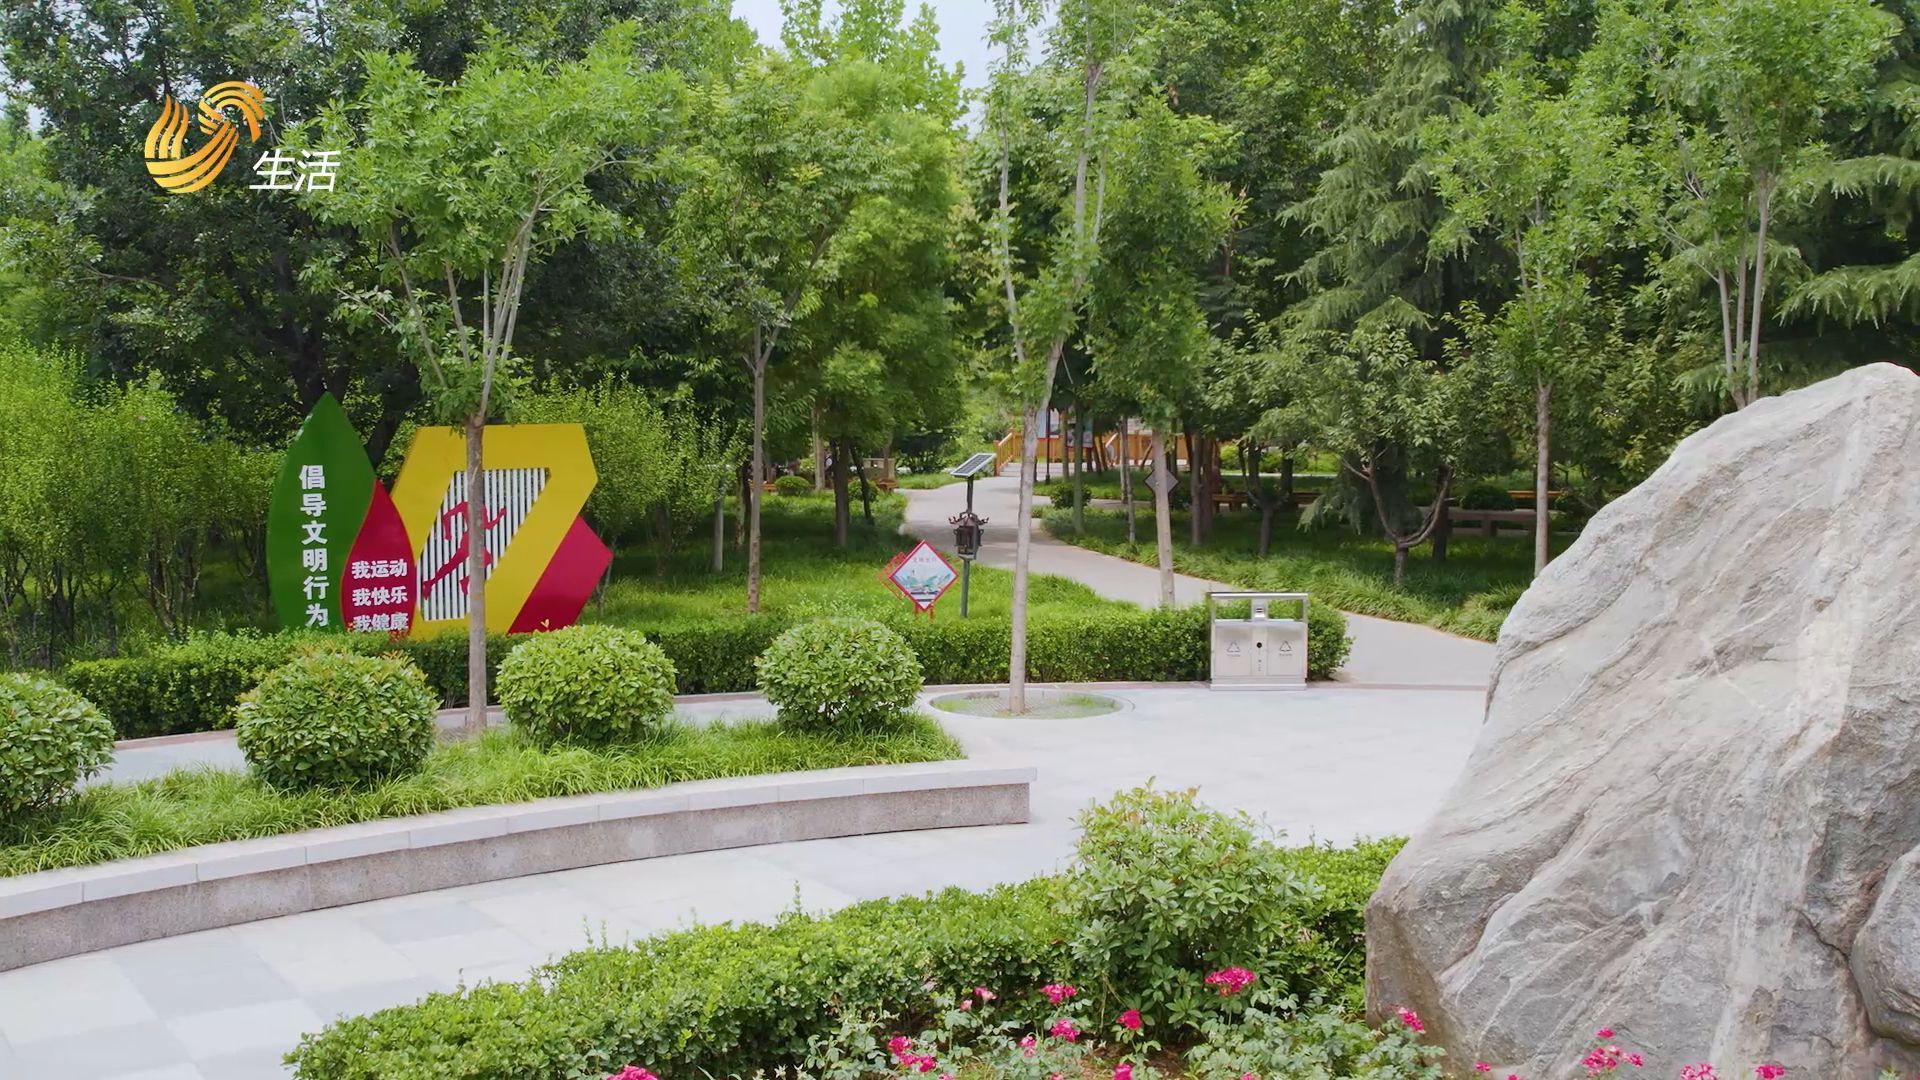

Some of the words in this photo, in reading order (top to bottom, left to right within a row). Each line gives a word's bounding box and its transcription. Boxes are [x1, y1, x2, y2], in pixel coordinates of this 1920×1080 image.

[299, 465, 330, 628] 倡导文明行为
[351, 558, 408, 579] 我运动
[352, 586, 408, 606] 我快乐
[353, 612, 409, 632] 我健康
